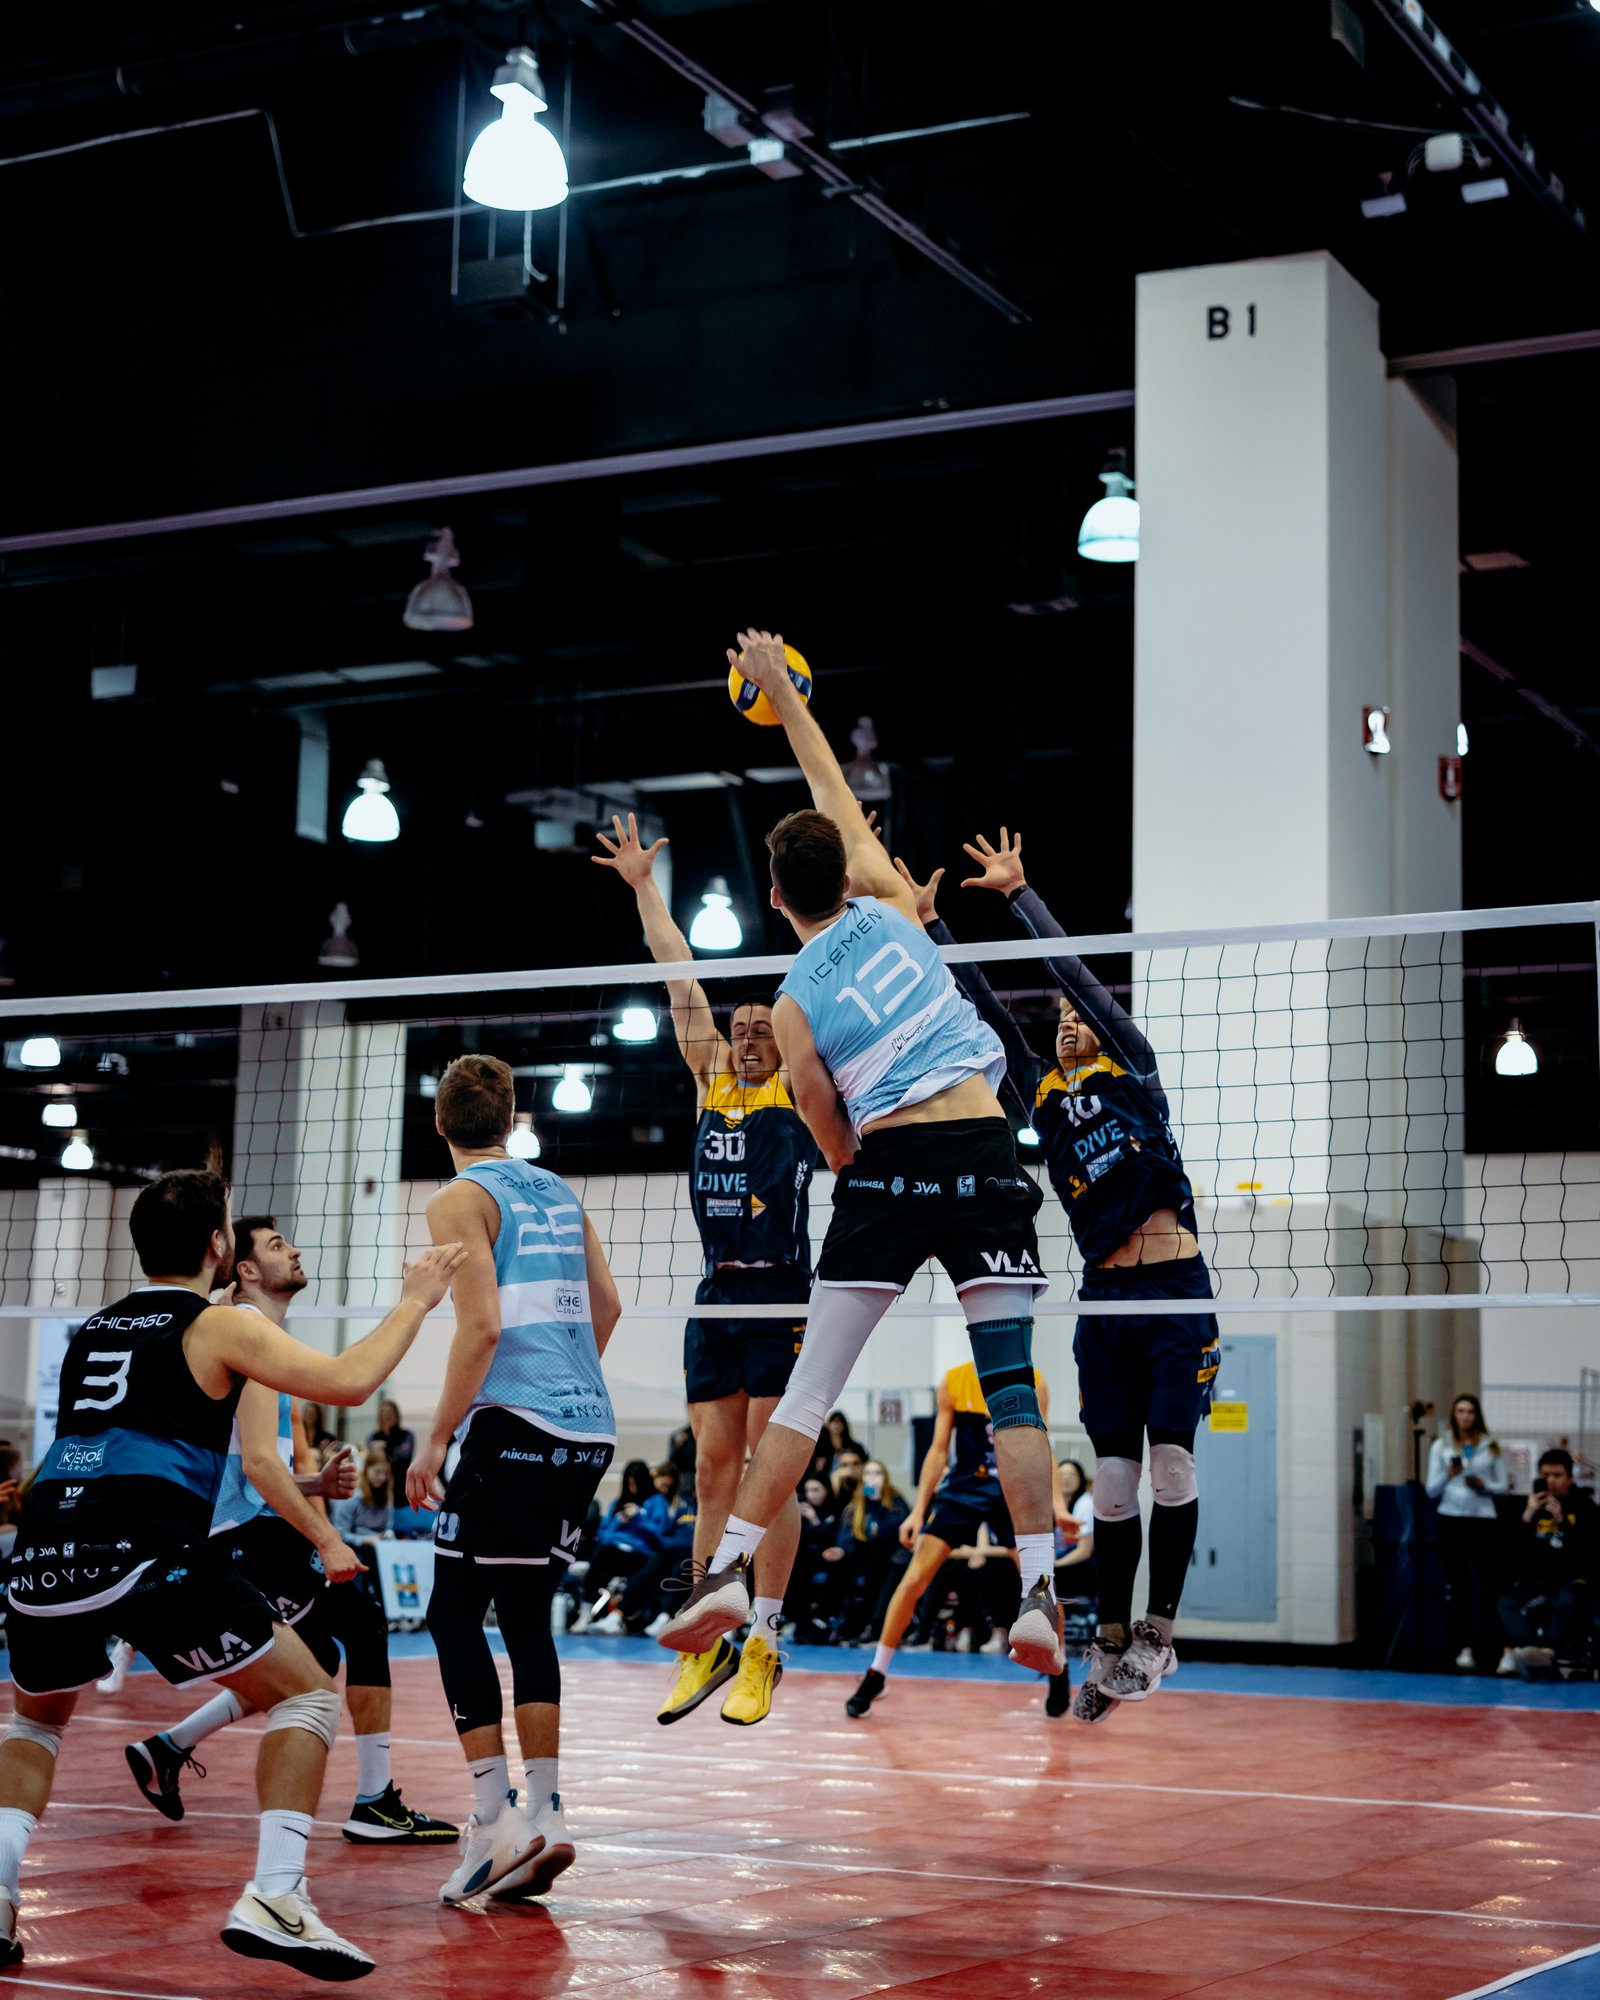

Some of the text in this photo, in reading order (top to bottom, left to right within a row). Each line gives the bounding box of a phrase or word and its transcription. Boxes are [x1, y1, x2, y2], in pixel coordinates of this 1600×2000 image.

[809, 908, 882, 985] ICEMEN
[835, 941, 924, 1027] 13
[704, 1130, 746, 1161] 30
[1074, 1119, 1125, 1161] DIVE
[697, 1171, 747, 1192] DIVE
[912, 1181, 941, 1194] JVA
[510, 1202, 585, 1256] 25
[980, 1249, 1039, 1274] VLA
[86, 1313, 173, 1330] CHICAGO
[73, 1350, 132, 1411] 3
[500, 1448, 543, 1462] MIKASA
[574, 1451, 591, 1462] JV
[39, 1547, 57, 1557] JVA
[173, 1631, 252, 1671] VLA
